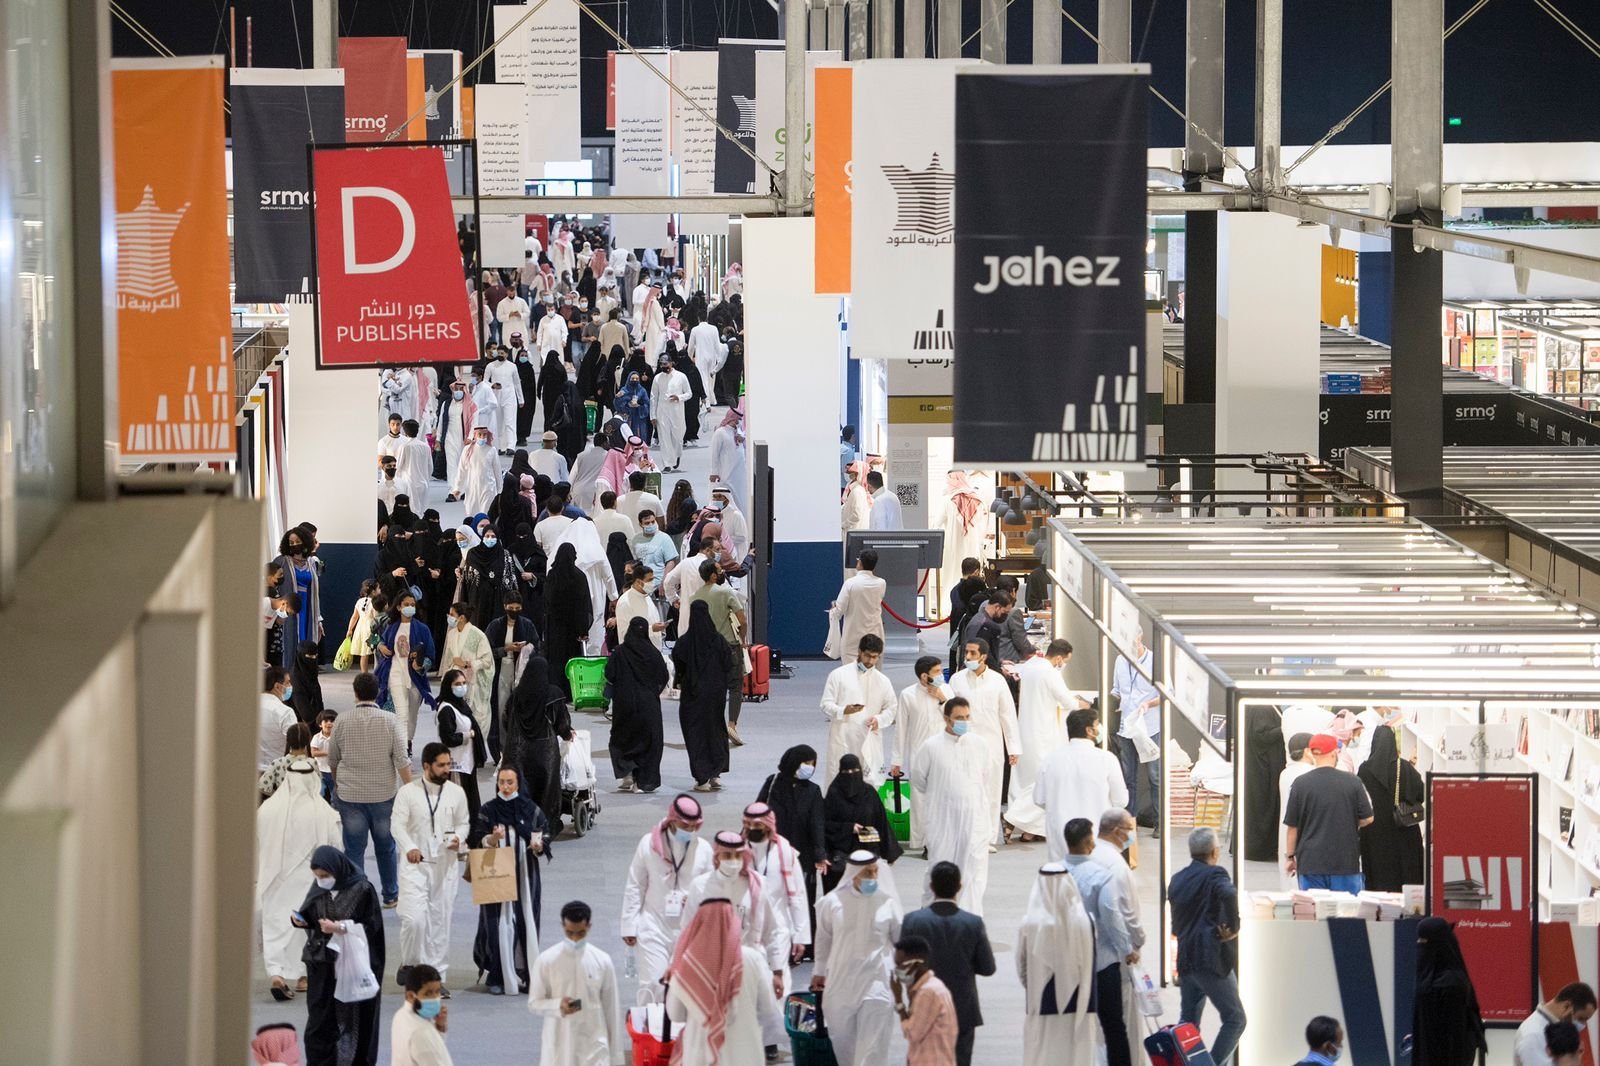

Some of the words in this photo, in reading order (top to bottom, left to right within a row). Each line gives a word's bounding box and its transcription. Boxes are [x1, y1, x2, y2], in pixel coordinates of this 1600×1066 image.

[345, 114, 388, 133] srmg
[341, 186, 416, 274] D
[886, 234, 916, 247] للعود
[129, 292, 181, 313] العربية
[359, 298, 402, 322] النشر
[408, 303, 436, 320] دور
[337, 322, 461, 343] PUBLISHERS
[1366, 409, 1391, 420] srm
[1456, 404, 1496, 420] srmg
[1331, 448, 1345, 458] sr
